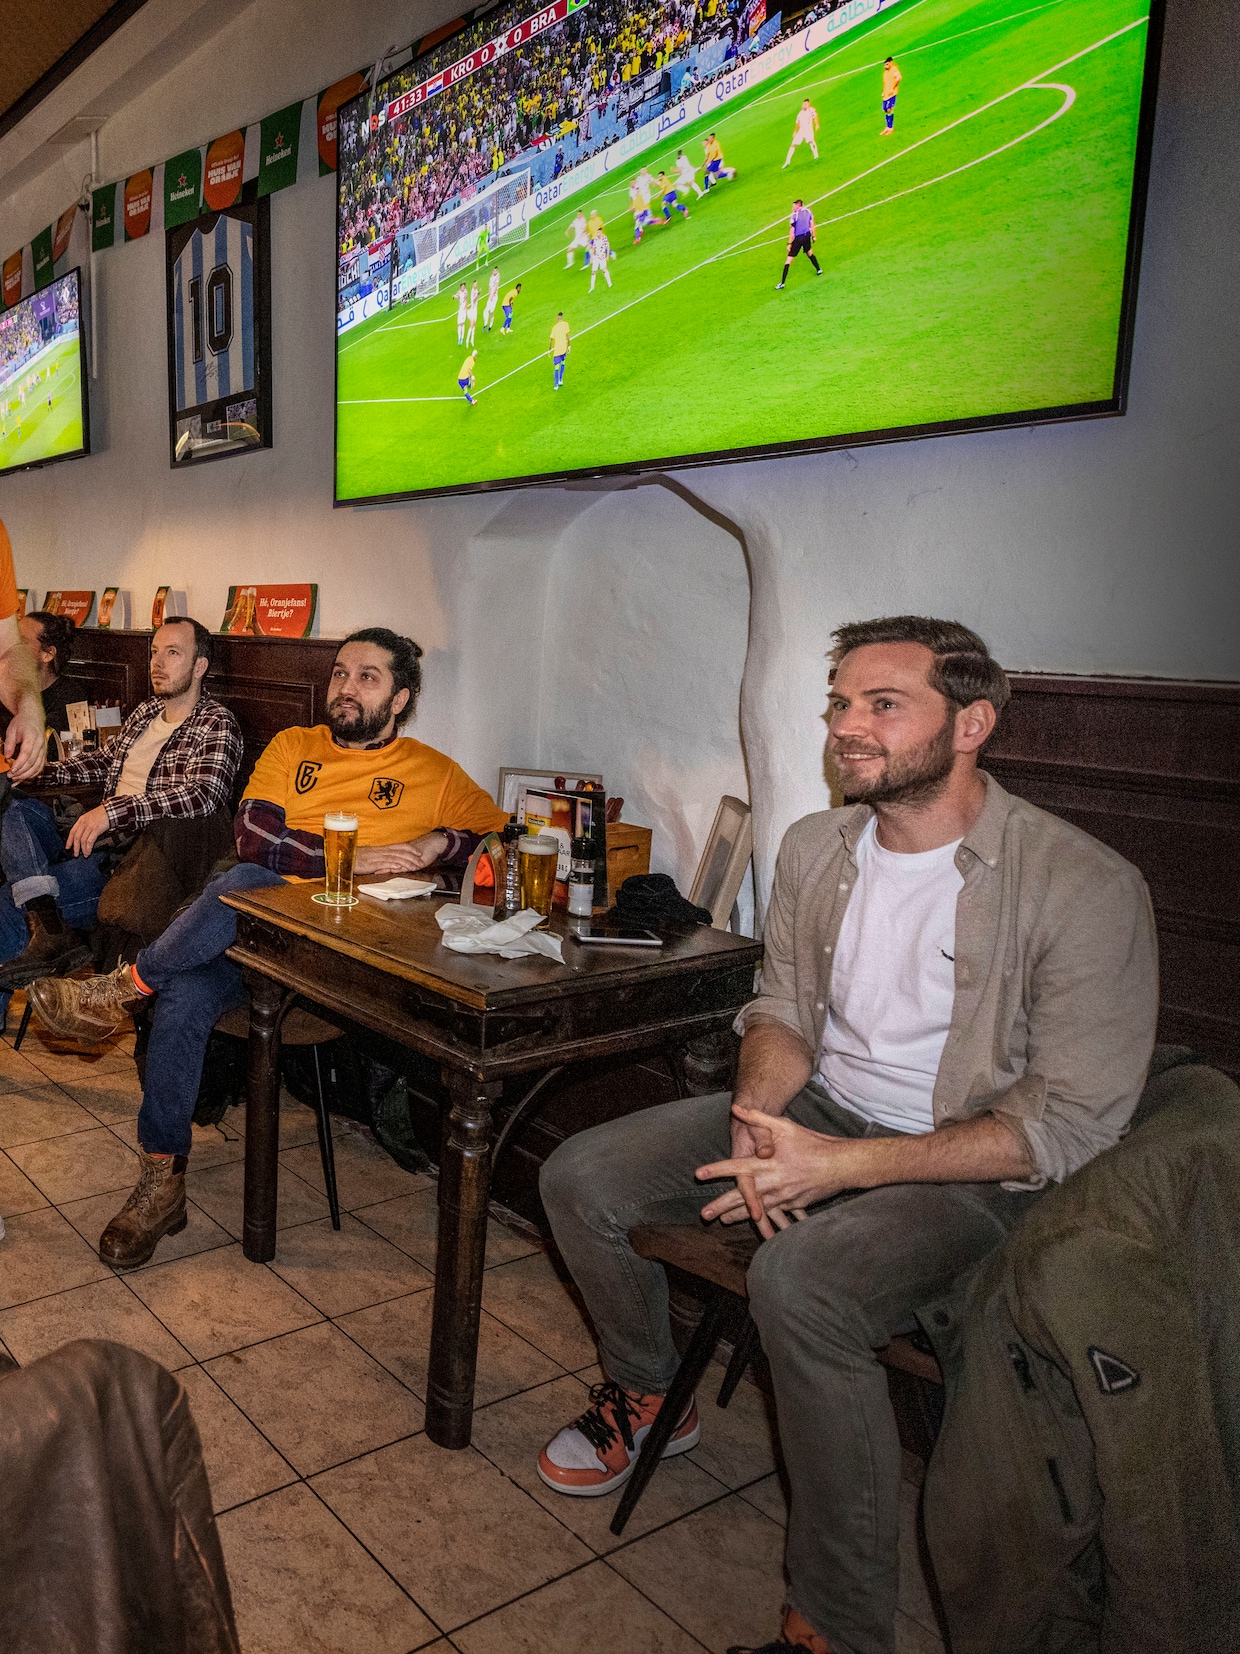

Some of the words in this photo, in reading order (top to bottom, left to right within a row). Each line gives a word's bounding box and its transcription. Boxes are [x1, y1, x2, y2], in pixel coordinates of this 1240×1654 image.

[451, 58, 474, 82] KRO
[480, 50, 489, 63] 0
[513, 30, 522, 42] 0
[530, 8, 557, 34] BRA
[715, 43, 793, 101] QatarEnergy
[393, 89, 423, 115] 41:33
[361, 109, 386, 138] NOS
[208, 166, 225, 178] HUIS
[534, 162, 596, 210] QatarEnergy
[170, 186, 195, 202] Heineken
[376, 259, 432, 307] QaarEnergy
[188, 262, 234, 364] 10
[267, 608, 294, 620] Biertje?
[270, 598, 307, 608] Oranjefans!
